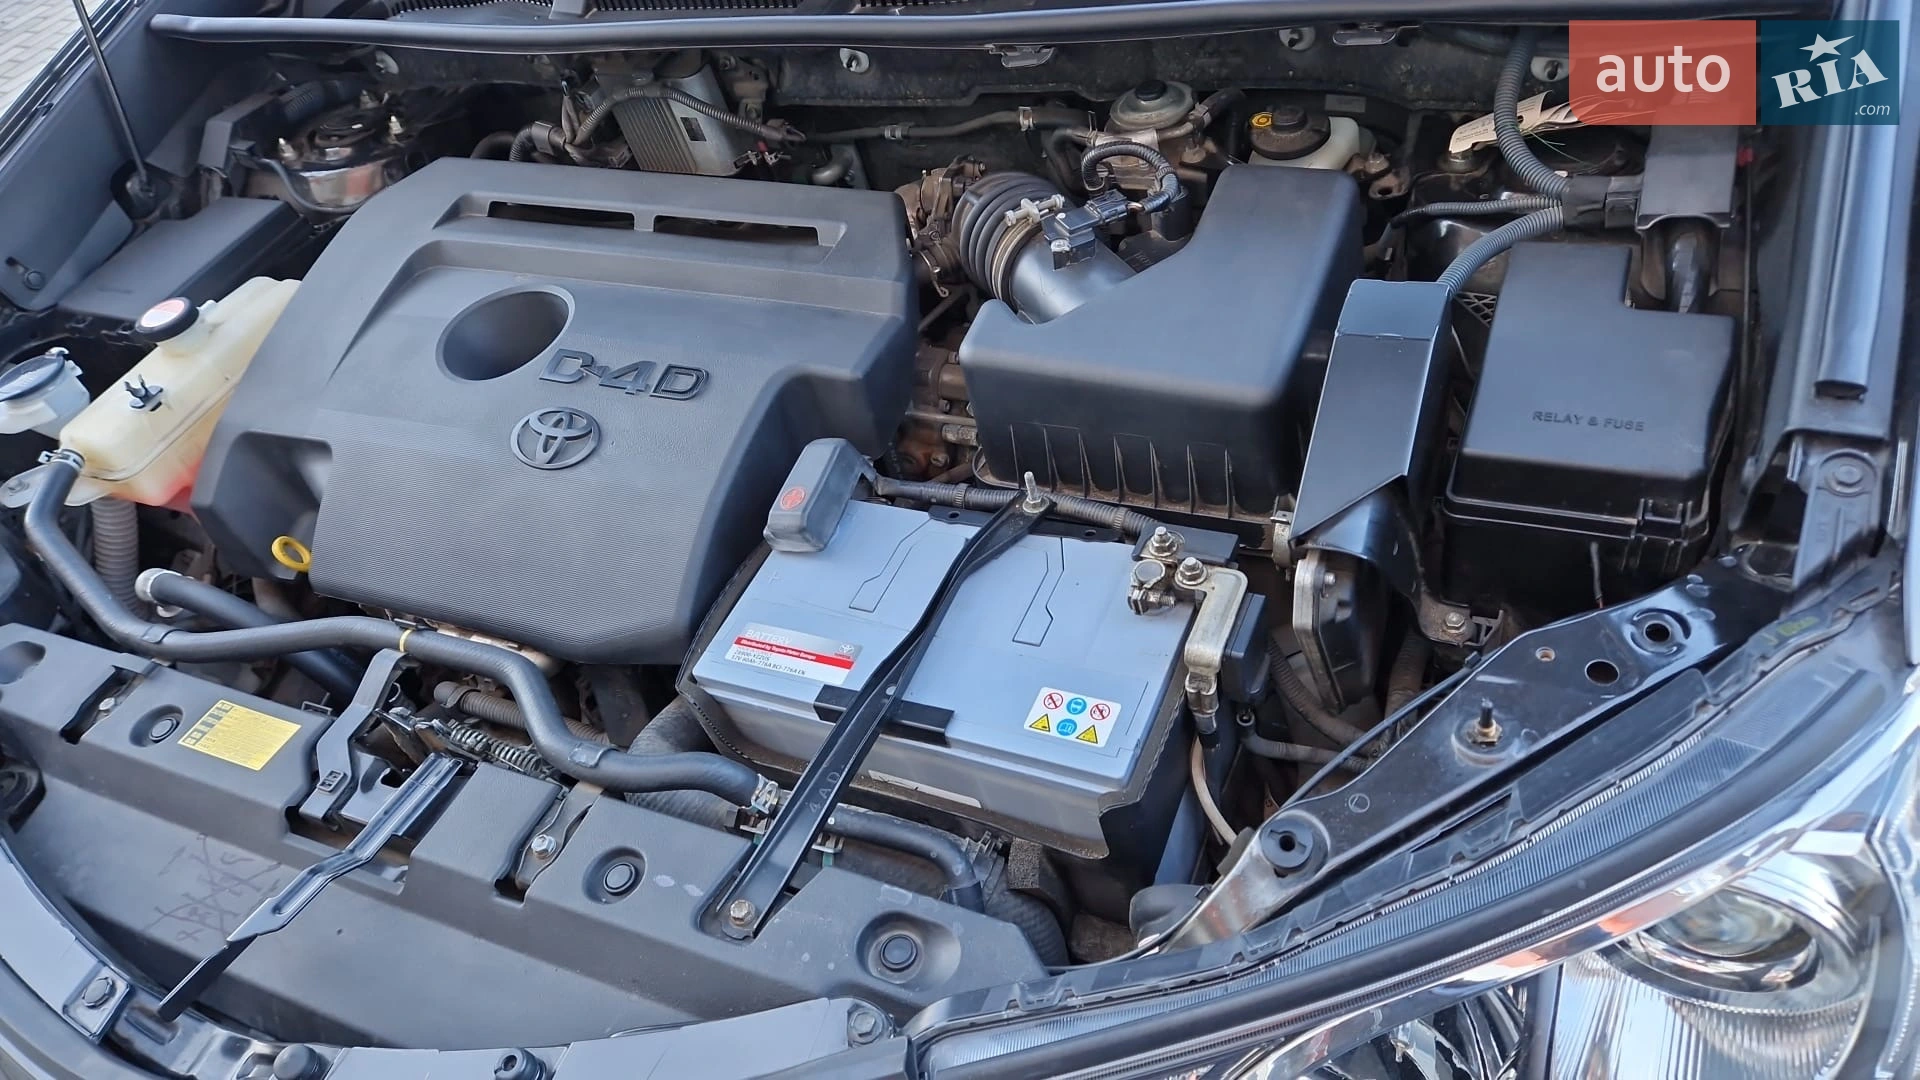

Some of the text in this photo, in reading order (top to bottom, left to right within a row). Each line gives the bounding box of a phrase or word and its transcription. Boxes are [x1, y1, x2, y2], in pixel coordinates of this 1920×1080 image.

[1532, 411, 1645, 432] RELAY & FUSE
[745, 629, 792, 644] BATTERY
